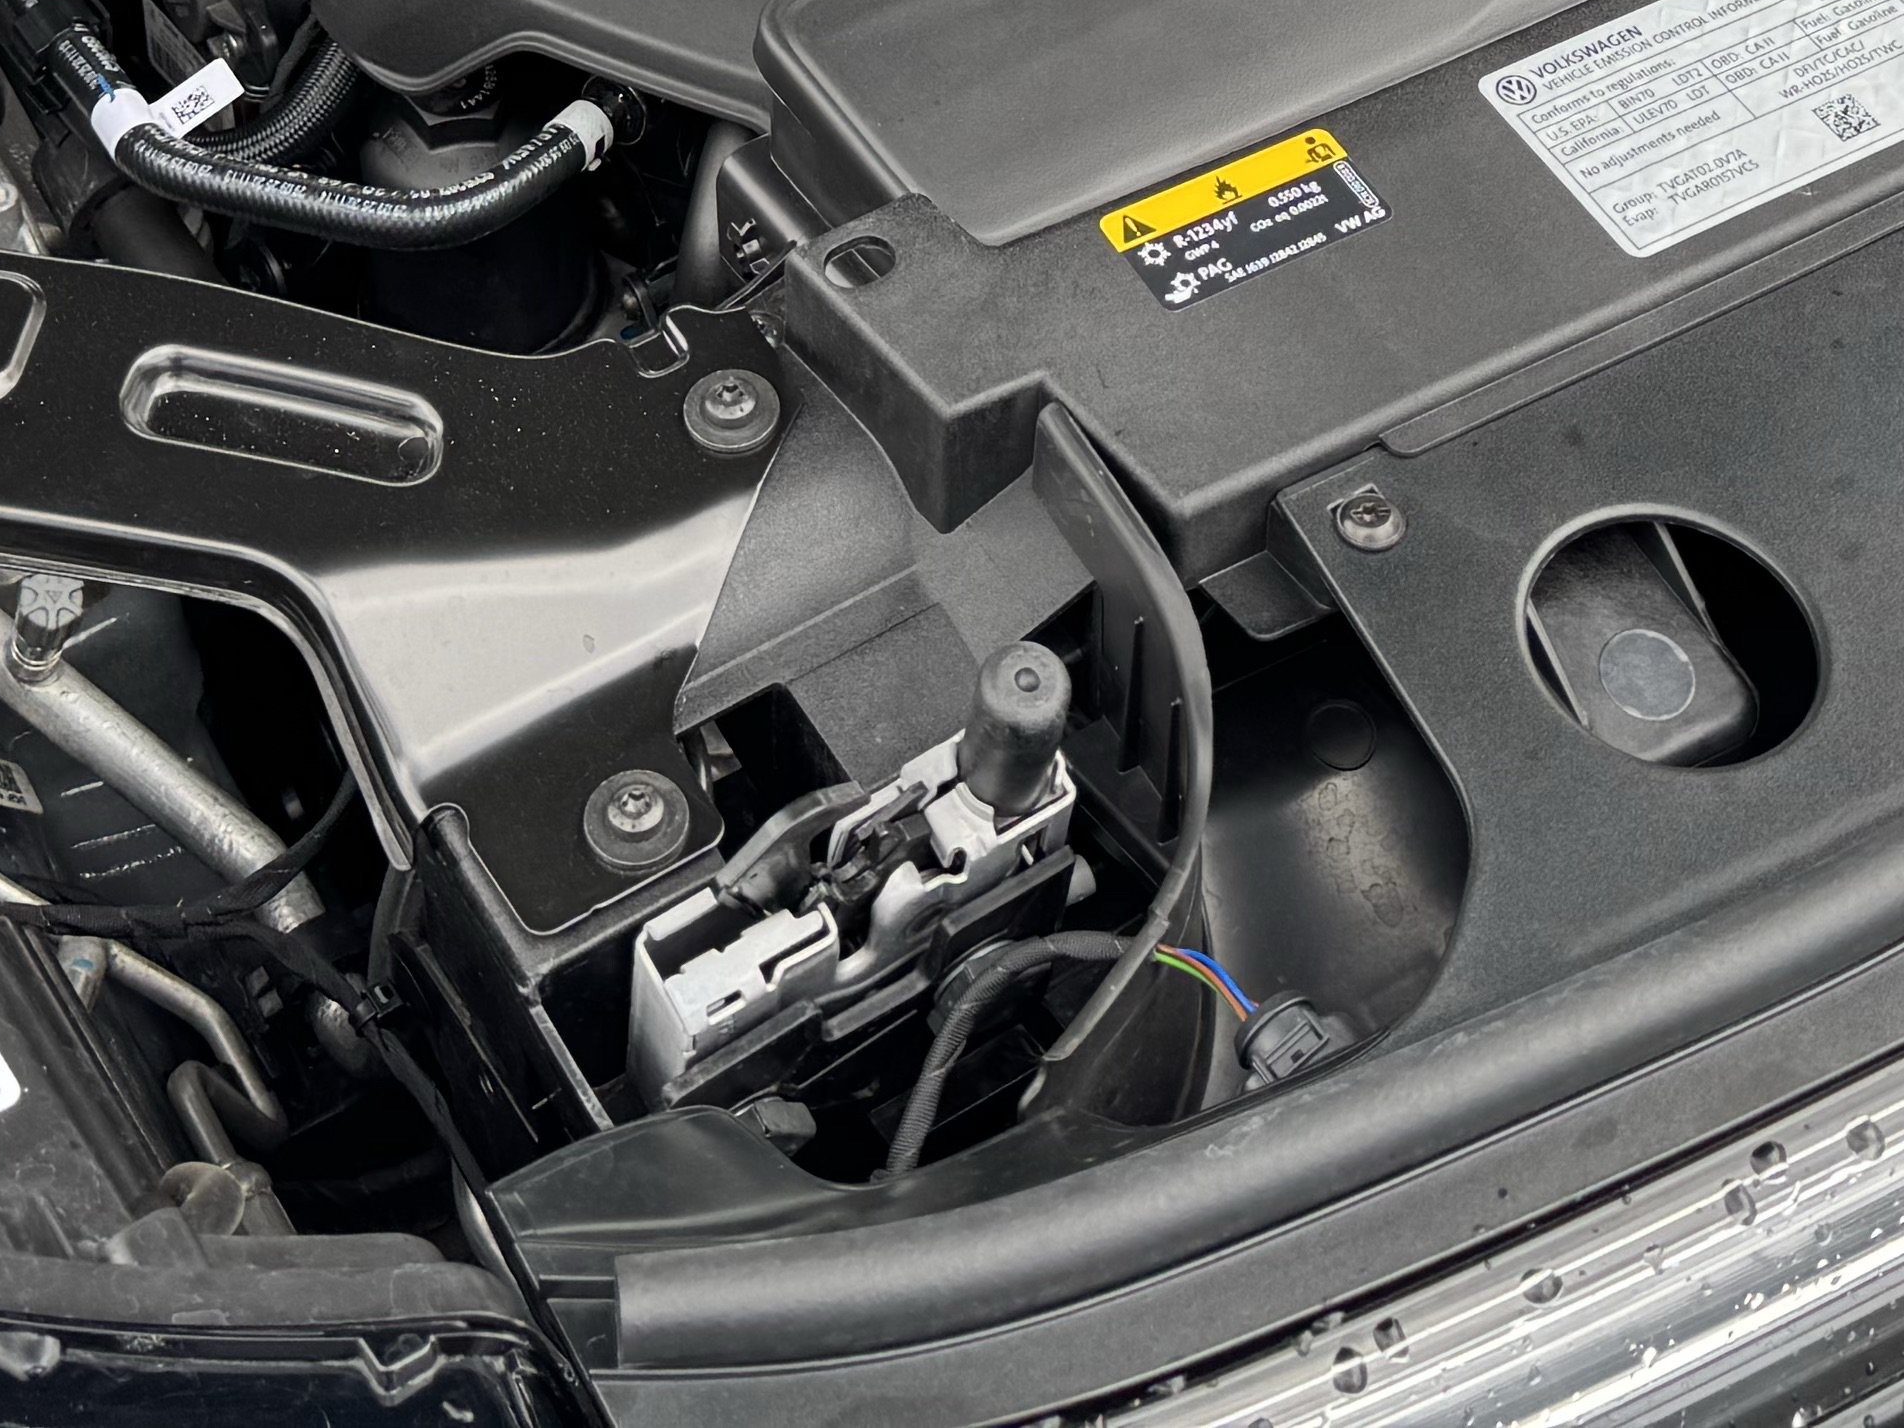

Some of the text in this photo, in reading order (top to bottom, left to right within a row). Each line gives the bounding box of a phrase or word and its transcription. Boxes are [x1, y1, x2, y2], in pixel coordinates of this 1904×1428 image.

[1529, 24, 1644, 80] VOLKSWAGEN
[1542, 63, 1596, 92] VEHICLE
[1592, 38, 1654, 70] EMISSION
[1650, 14, 1710, 45] CONTROL
[1529, 93, 1592, 125] Conforms
[1587, 86, 1607, 100] to
[1602, 56, 1678, 94] regulations:
[1544, 124, 1573, 142] U.S.
[1569, 112, 1600, 131] EPA:
[1617, 87, 1657, 109] BIN70
[1670, 67, 1704, 86] LDT2
[1708, 49, 1744, 70] OBD:
[1742, 40, 1766, 55] CA
[1761, 35, 1777, 47] II
[1799, 11, 1832, 31] Fuel:
[1558, 3, 1900, 158] California: ULEV70 LDT OBD: CA II Fuel: Gasoline
[1578, 109, 1722, 179] No adjustments needed
[1169, 209, 1244, 252] R-1234yf
[1264, 186, 1302, 208] 0.550
[1298, 177, 1324, 197] kg
[1272, 210, 1292, 224] eq
[1332, 204, 1388, 235] VW AG
[1610, 187, 1660, 216] Group:
[1621, 203, 1662, 228] Evap:
[1182, 239, 1221, 262] GWP 4
[1195, 256, 1235, 281] PAG
[1222, 266, 1248, 283] SAE
